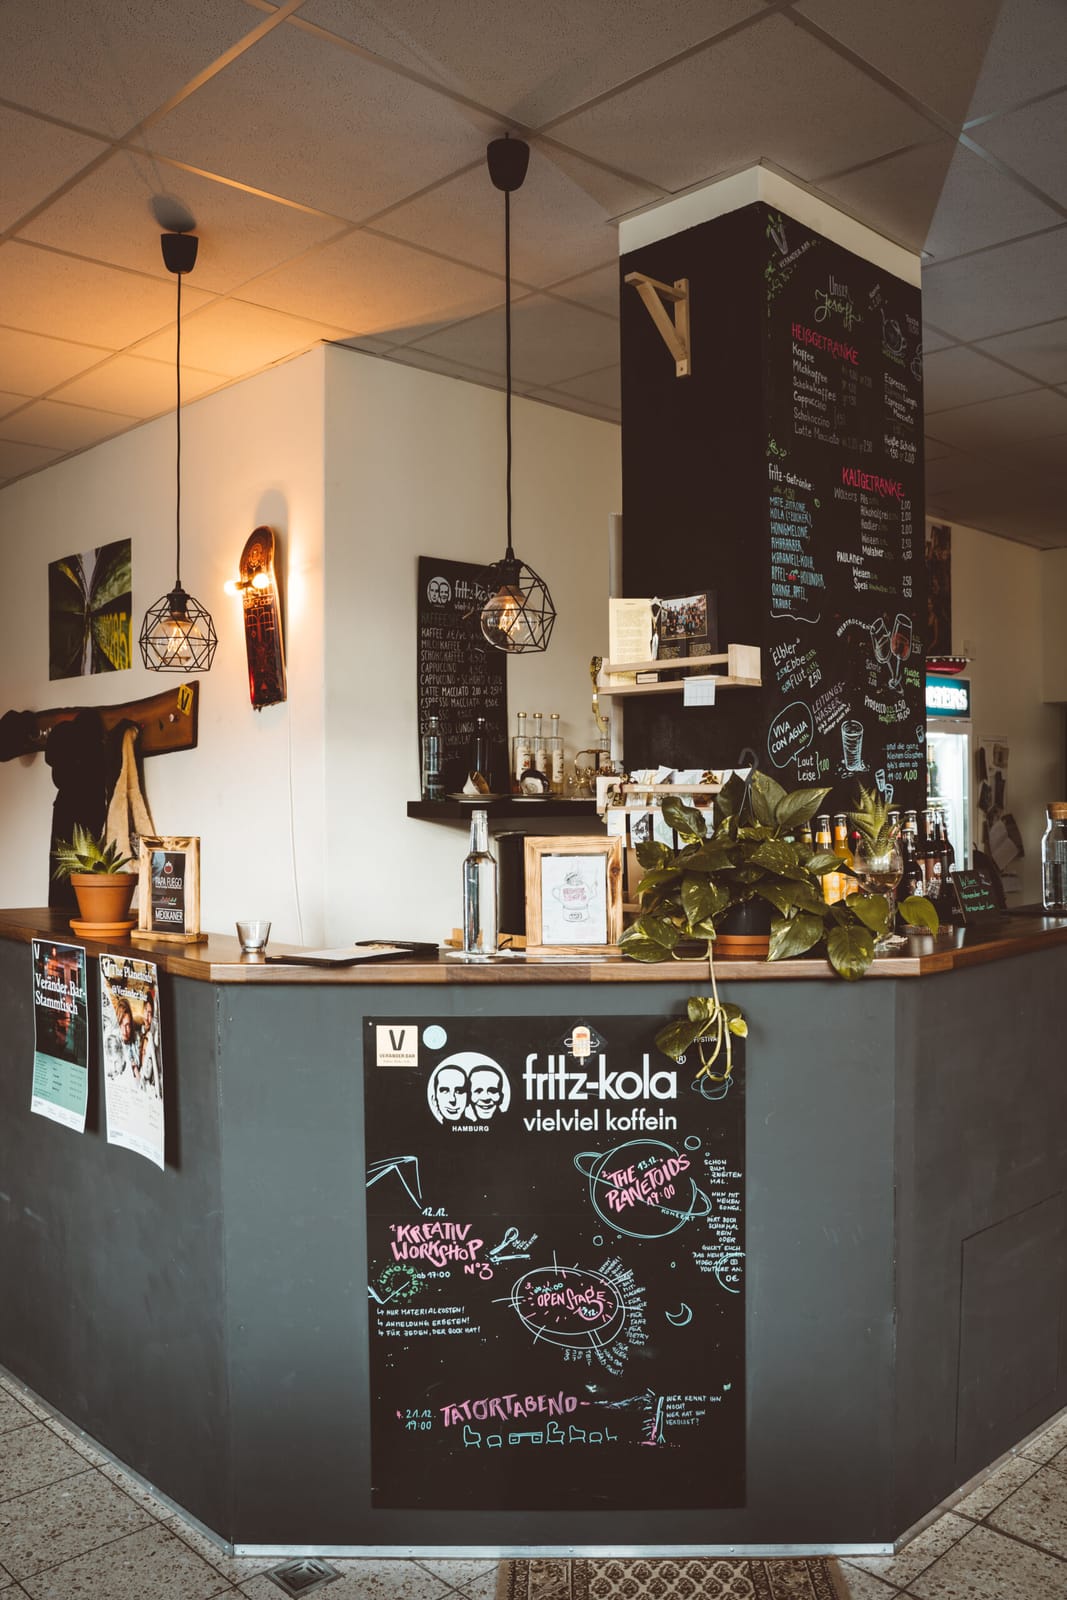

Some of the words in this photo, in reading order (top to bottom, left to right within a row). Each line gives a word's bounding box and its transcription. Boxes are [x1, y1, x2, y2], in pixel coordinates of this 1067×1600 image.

[792, 341, 815, 363] Kaffee
[792, 359, 828, 384] Milchkaffee
[853, 577, 868, 592] Spezi
[421, 627, 444, 640] KAFFEE
[785, 656, 806, 673] Ebbe
[420, 686, 439, 696] LATTE
[864, 695, 886, 714] Prosecco
[772, 736, 788, 753] CON
[788, 720, 808, 743] AGUA
[773, 721, 791, 738] VIVA
[797, 755, 813, 768] Laut
[797, 770, 816, 781] Leise
[155, 877, 166, 888] PAPA
[167, 877, 182, 888] FUEGO
[34, 944, 40, 959] V
[35, 990, 78, 1015] Stammtisch
[389, 1030, 405, 1051] V
[693, 1036, 717, 1044] FSTIVA
[522, 1053, 677, 1100] fritz-kola
[523, 1109, 598, 1131] vielviel
[607, 1108, 677, 1131] koffein
[605, 1153, 691, 1213] PLANETOIDS
[607, 1165, 637, 1188] THE
[646, 1184, 675, 1206] 19:00
[422, 1207, 448, 1217] 12.12.
[396, 1221, 472, 1244] KREATIV
[390, 1239, 484, 1268] WORKSHOP
[417, 1271, 426, 1279] ab
[427, 1271, 451, 1279] 17:00
[537, 1292, 566, 1308] OPEN
[386, 1308, 400, 1316] NUR
[401, 1306, 465, 1316] MATERIALKOSTEN!
[385, 1319, 430, 1328] ANMELDUNG
[432, 1317, 470, 1327] ERBETEN!
[386, 1329, 401, 1337] FÜR
[432, 1328, 446, 1336] DER
[440, 1390, 577, 1428] TATORTABEND
[405, 1420, 432, 1430] 19:00
